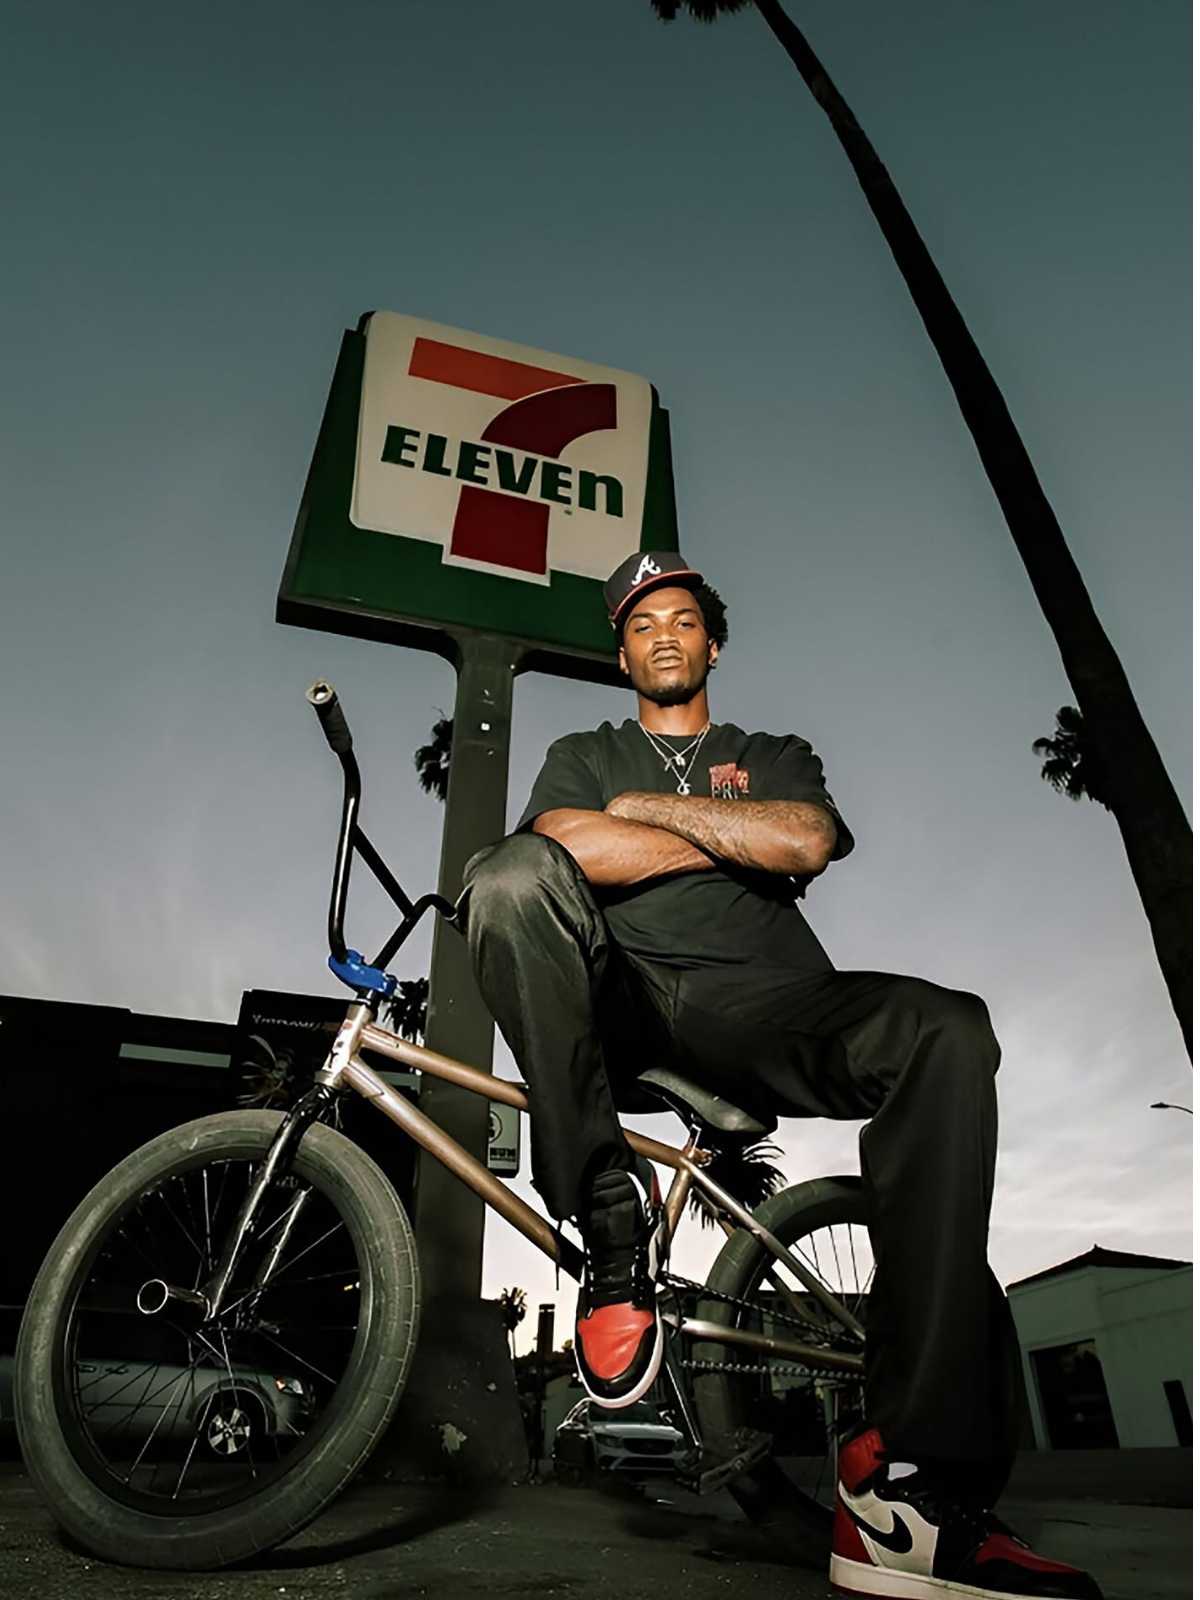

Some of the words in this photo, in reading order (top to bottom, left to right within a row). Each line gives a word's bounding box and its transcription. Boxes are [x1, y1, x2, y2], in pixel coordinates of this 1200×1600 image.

[381, 425, 624, 518] ELEVEn
[408, 337, 617, 575] 7
[631, 554, 662, 586] A
